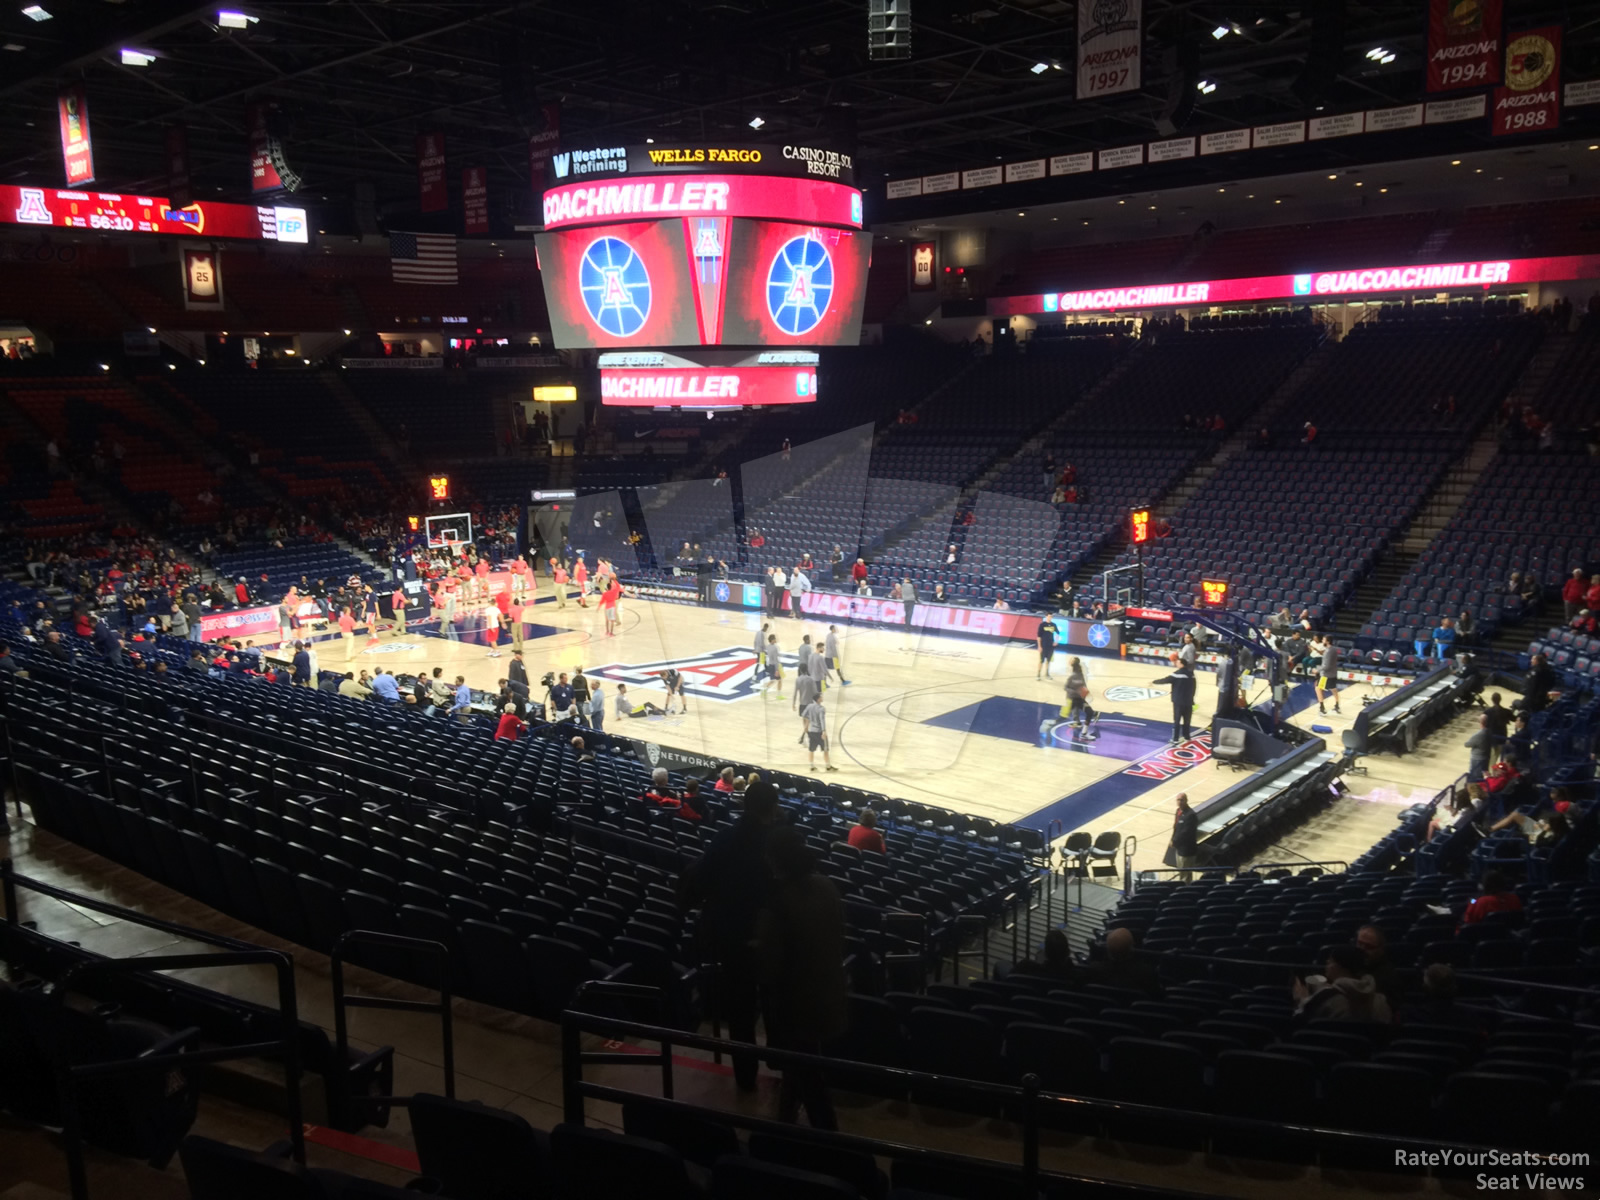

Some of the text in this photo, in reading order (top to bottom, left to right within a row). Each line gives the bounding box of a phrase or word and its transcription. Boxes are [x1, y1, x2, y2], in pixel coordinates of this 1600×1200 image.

[1081, 45, 1138, 67] ARIZONA
[1431, 40, 1497, 62] ARIZONA
[1089, 69, 1129, 91] 1997
[1441, 62, 1487, 84] 1994
[1496, 90, 1556, 110] ARIZONA
[1505, 110, 1548, 130] 1988
[572, 147, 626, 162] Western
[648, 149, 762, 162] WELLS FARGO
[782, 145, 852, 169] CASINO DEL SOL
[573, 159, 627, 174] Refining
[807, 161, 840, 177] RESORT
[90, 214, 134, 231] 56:10
[279, 220, 302, 233] TEP
[918, 262, 929, 272] 00
[196, 272, 208, 282] 25
[1315, 262, 1510, 293] @UACOACHMILLER
[1061, 283, 1209, 312] @UACOACHMILLER
[411, 359, 434, 368] CLUB
[601, 375, 740, 398] OACHMILLER
[434, 485, 447, 498] 30
[1135, 523, 1146, 541] 30
[1208, 592, 1220, 602] 30
[660, 751, 716, 769] NETWORKS
